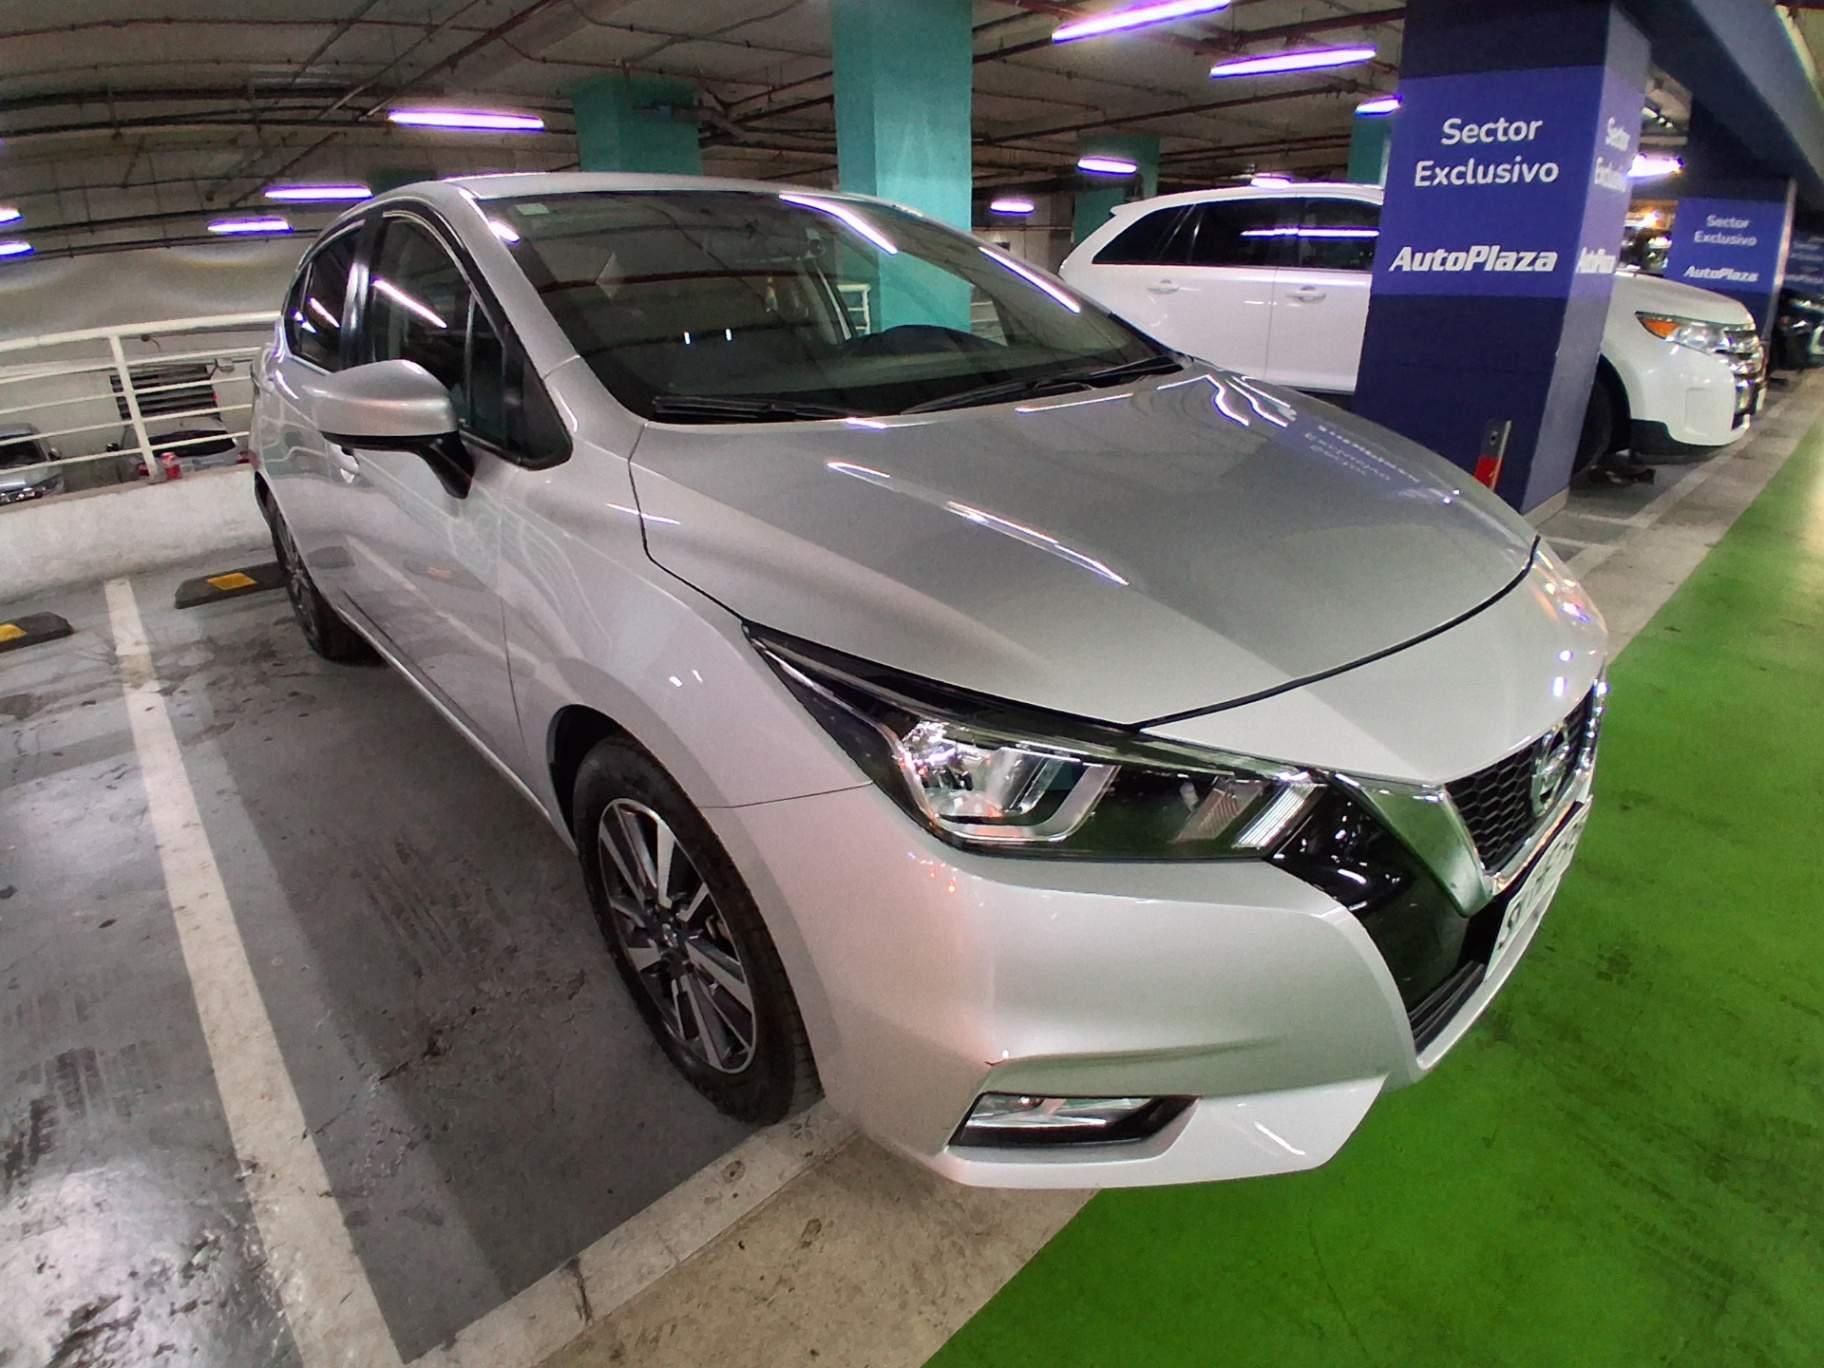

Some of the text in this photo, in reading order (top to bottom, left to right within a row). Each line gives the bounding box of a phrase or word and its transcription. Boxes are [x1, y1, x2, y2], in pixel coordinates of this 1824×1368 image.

[1441, 117, 1543, 145] Sector
[1414, 155, 1559, 187] Exclusivo
[1706, 214, 1750, 229] Sector
[1694, 230, 1757, 247] Exclusivo
[1388, 245, 1558, 272] AutoPlaza
[1683, 265, 1759, 282] AutoPlaza
